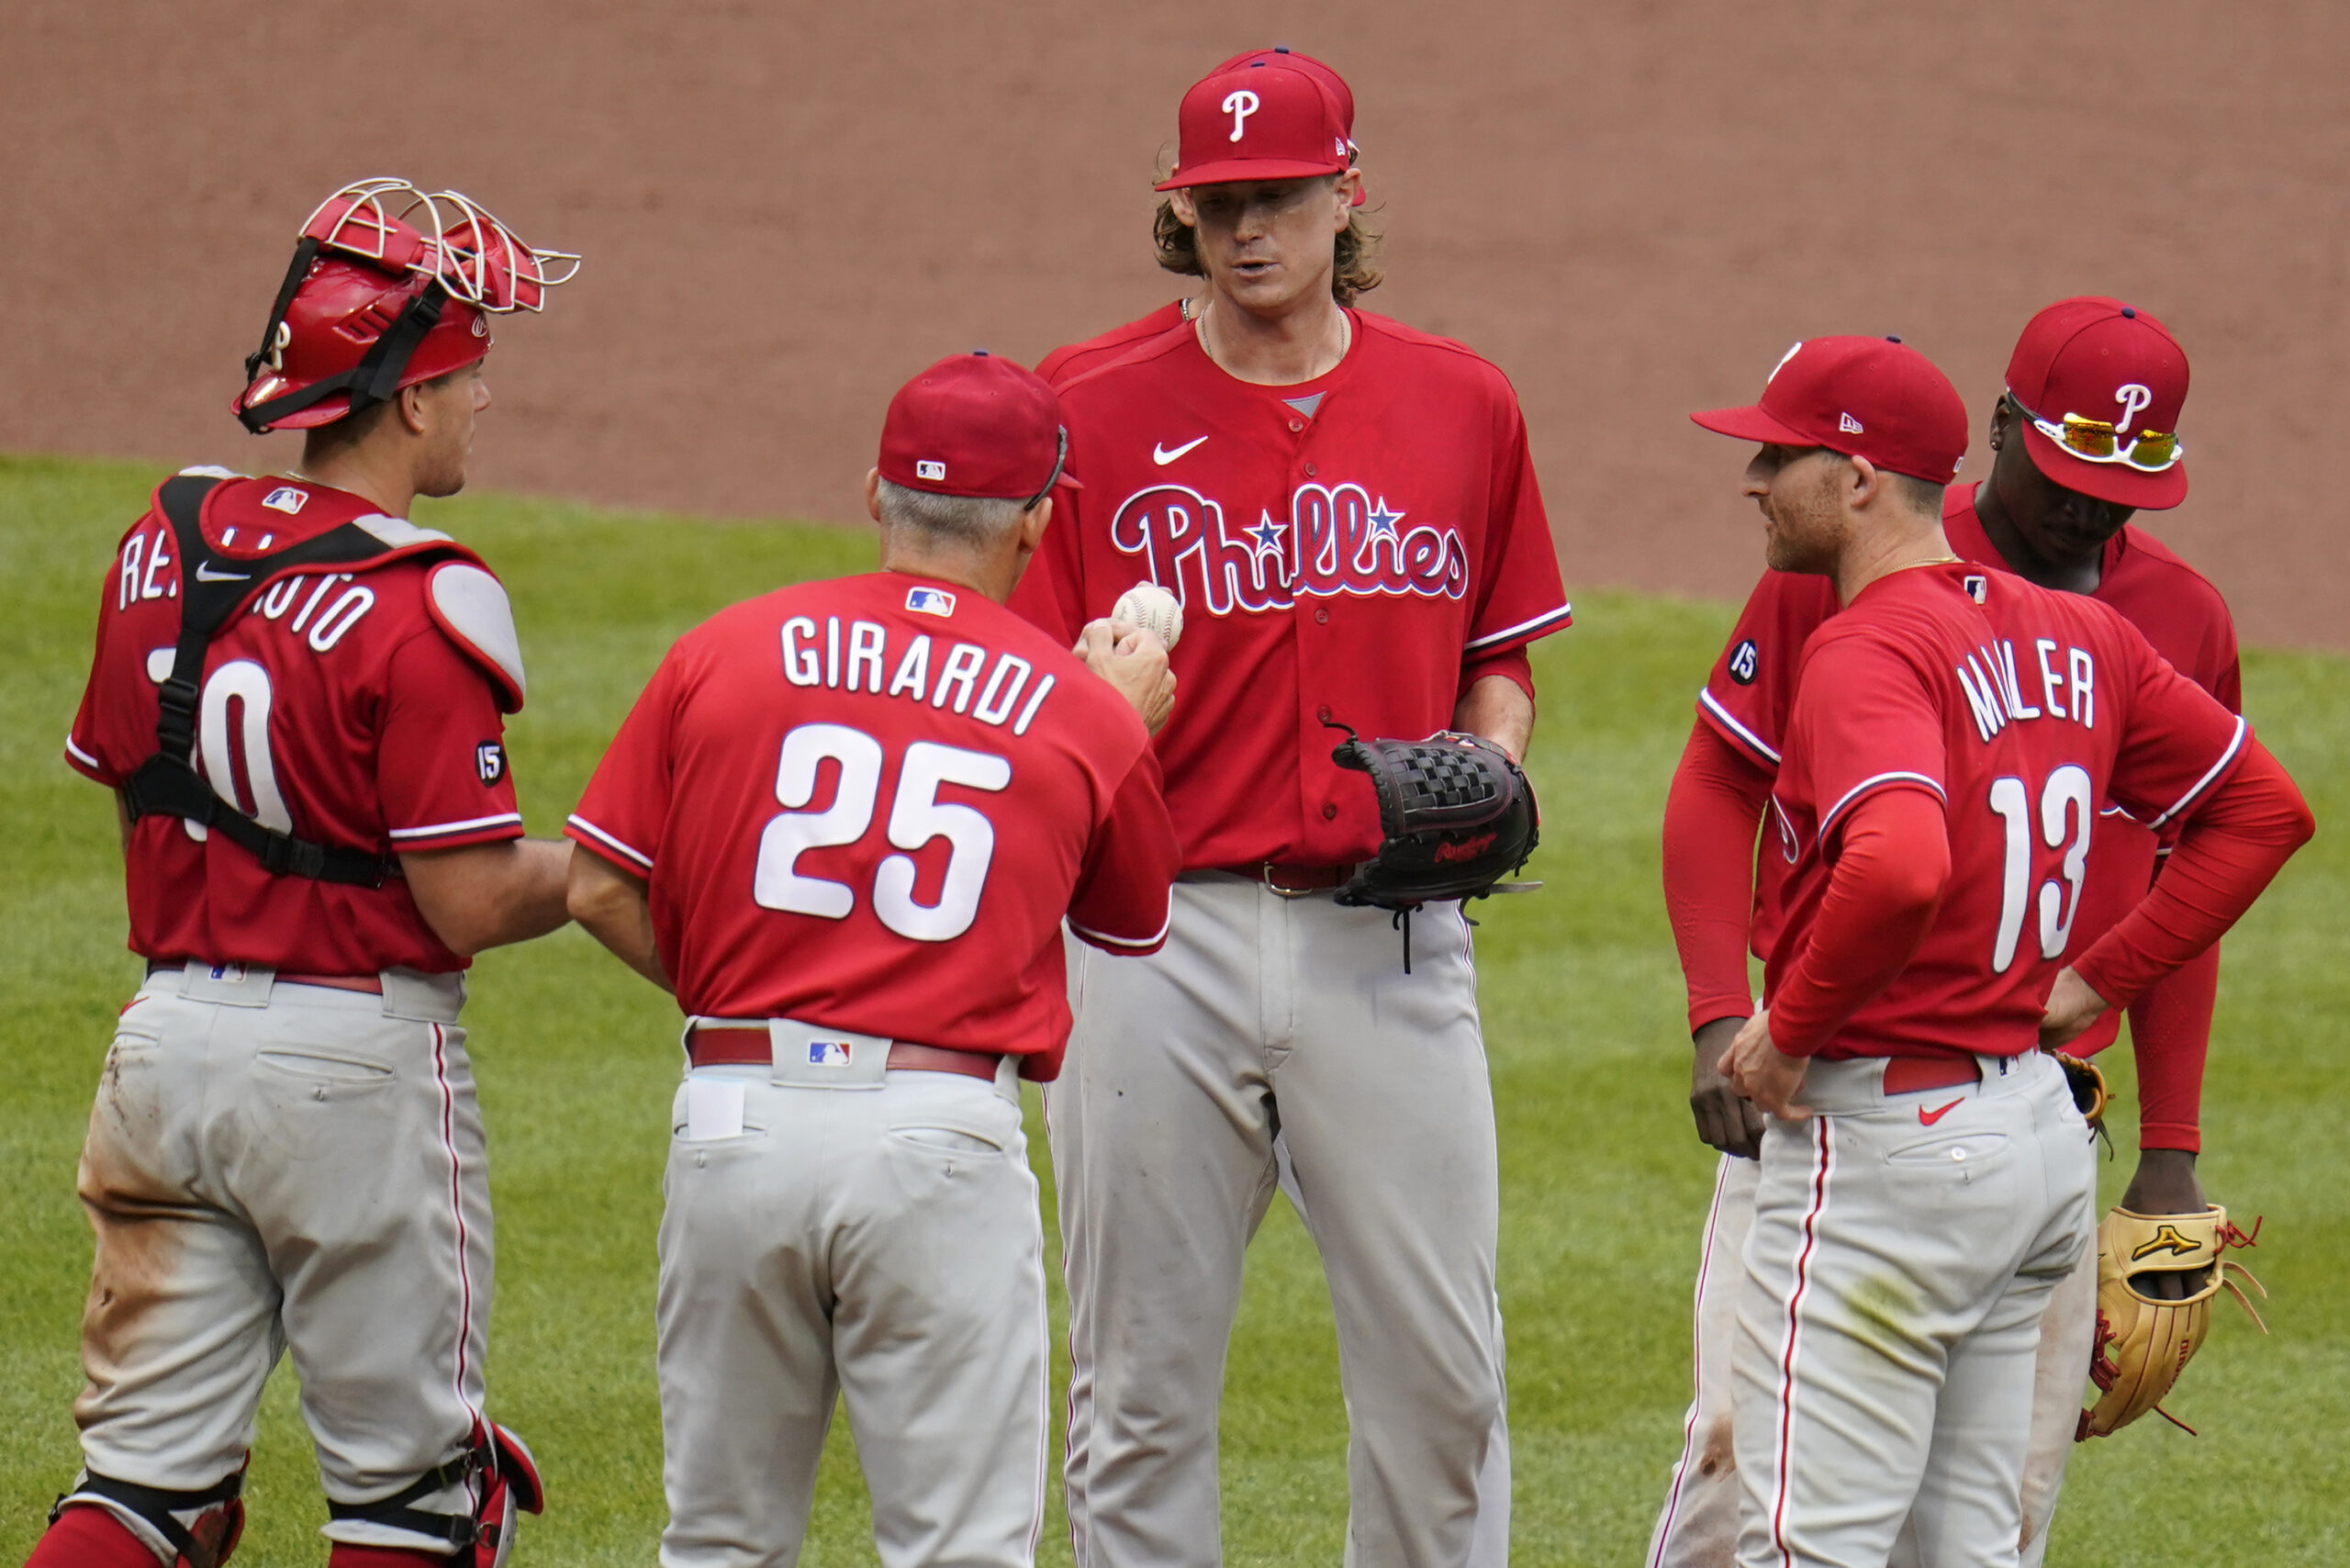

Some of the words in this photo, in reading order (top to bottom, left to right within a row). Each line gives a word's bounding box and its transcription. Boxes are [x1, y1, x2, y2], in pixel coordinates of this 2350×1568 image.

[1222, 90, 1259, 142] P
[2115, 384, 2152, 434] P
[118, 527, 375, 652] REUTO
[1111, 483, 1469, 615] Phillies
[780, 616, 1056, 736] GIRARDI
[1730, 642, 1757, 679] 15
[146, 645, 295, 843] 0
[477, 745, 501, 780] 15
[753, 722, 1013, 943] 25
[1988, 763, 2092, 974] 13
